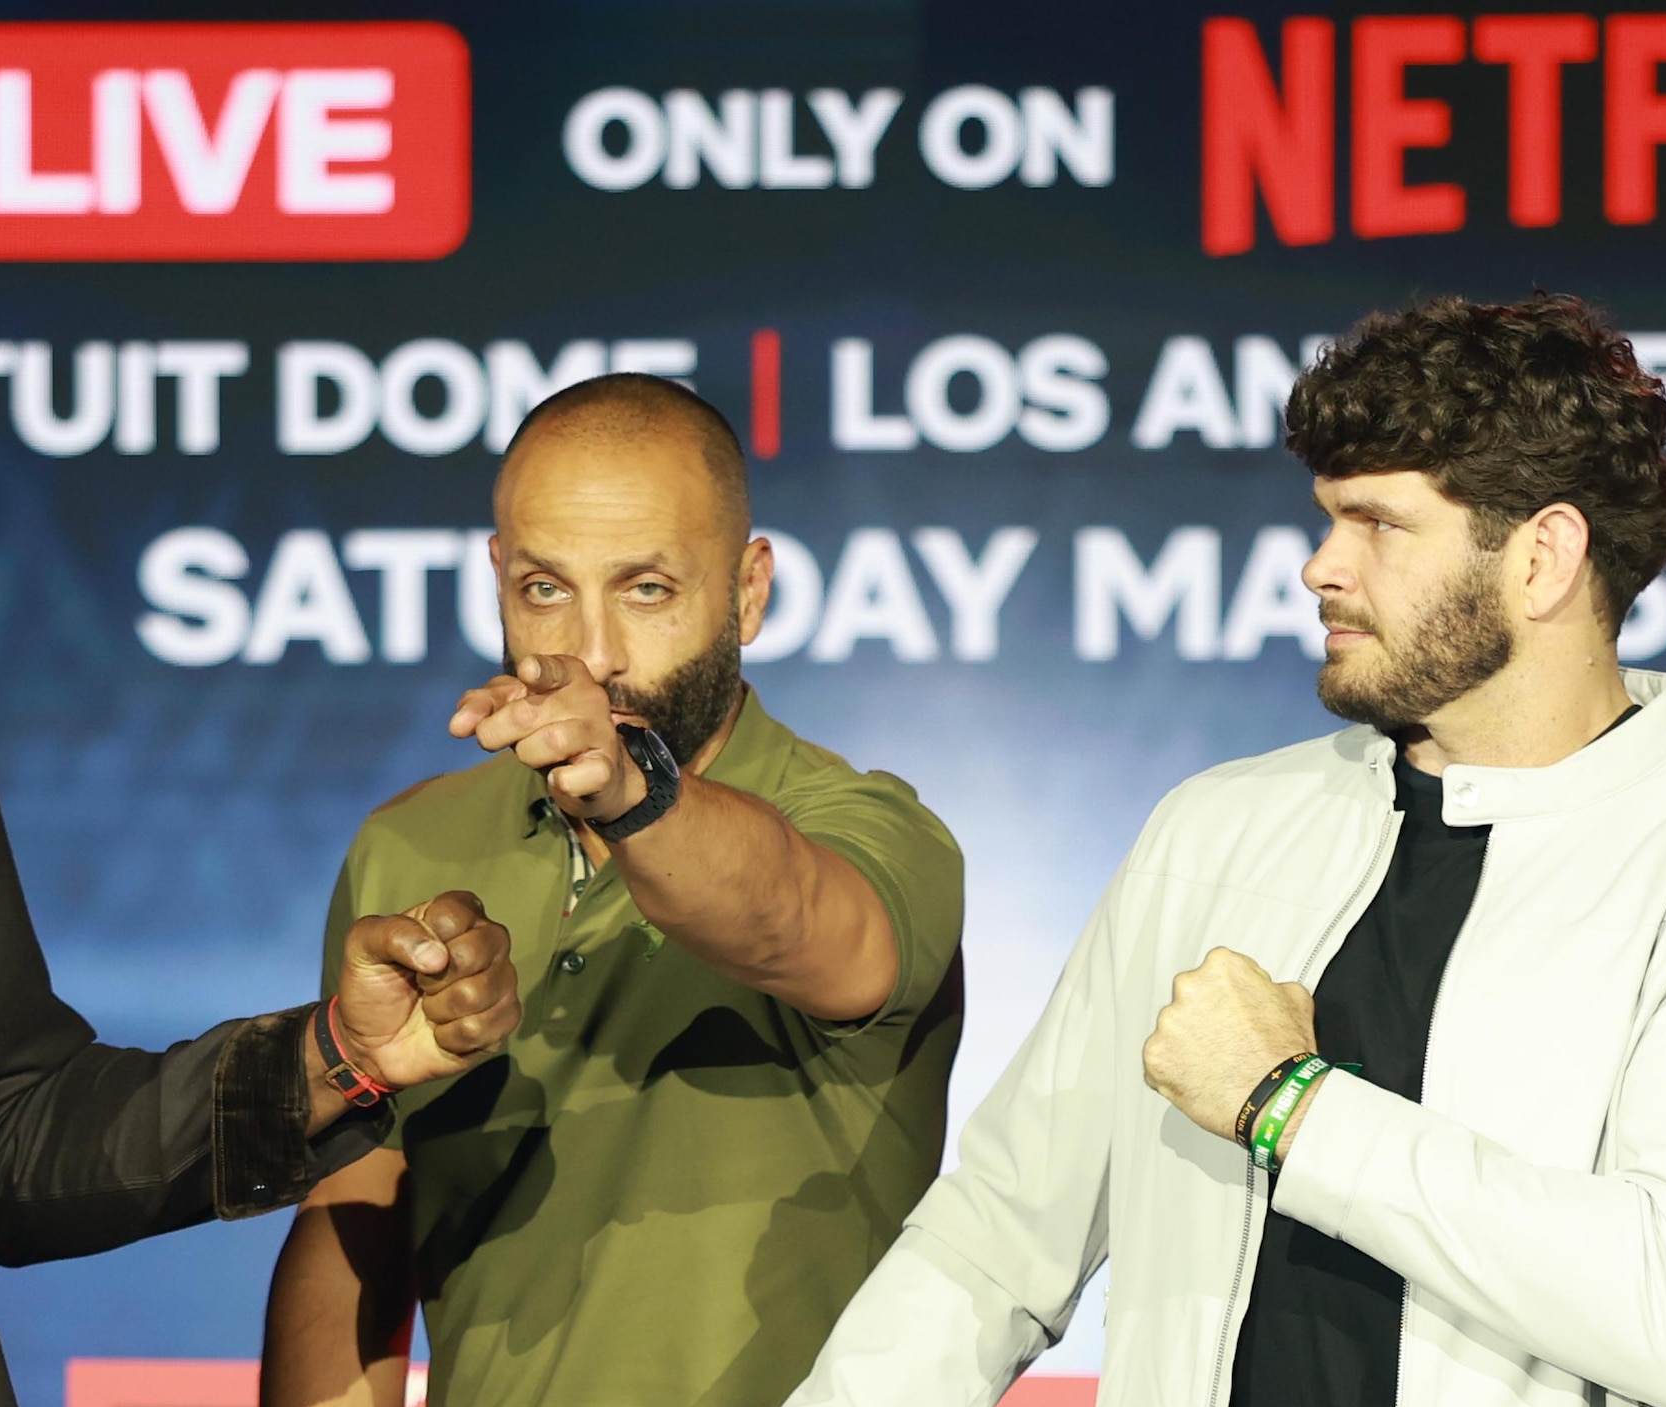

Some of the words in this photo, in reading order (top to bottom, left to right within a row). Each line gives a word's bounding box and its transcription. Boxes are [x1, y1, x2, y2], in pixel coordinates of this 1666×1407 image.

[564, 87, 901, 191] ONLY
[921, 86, 1113, 190] ON
[832, 336, 1109, 452] LOS
